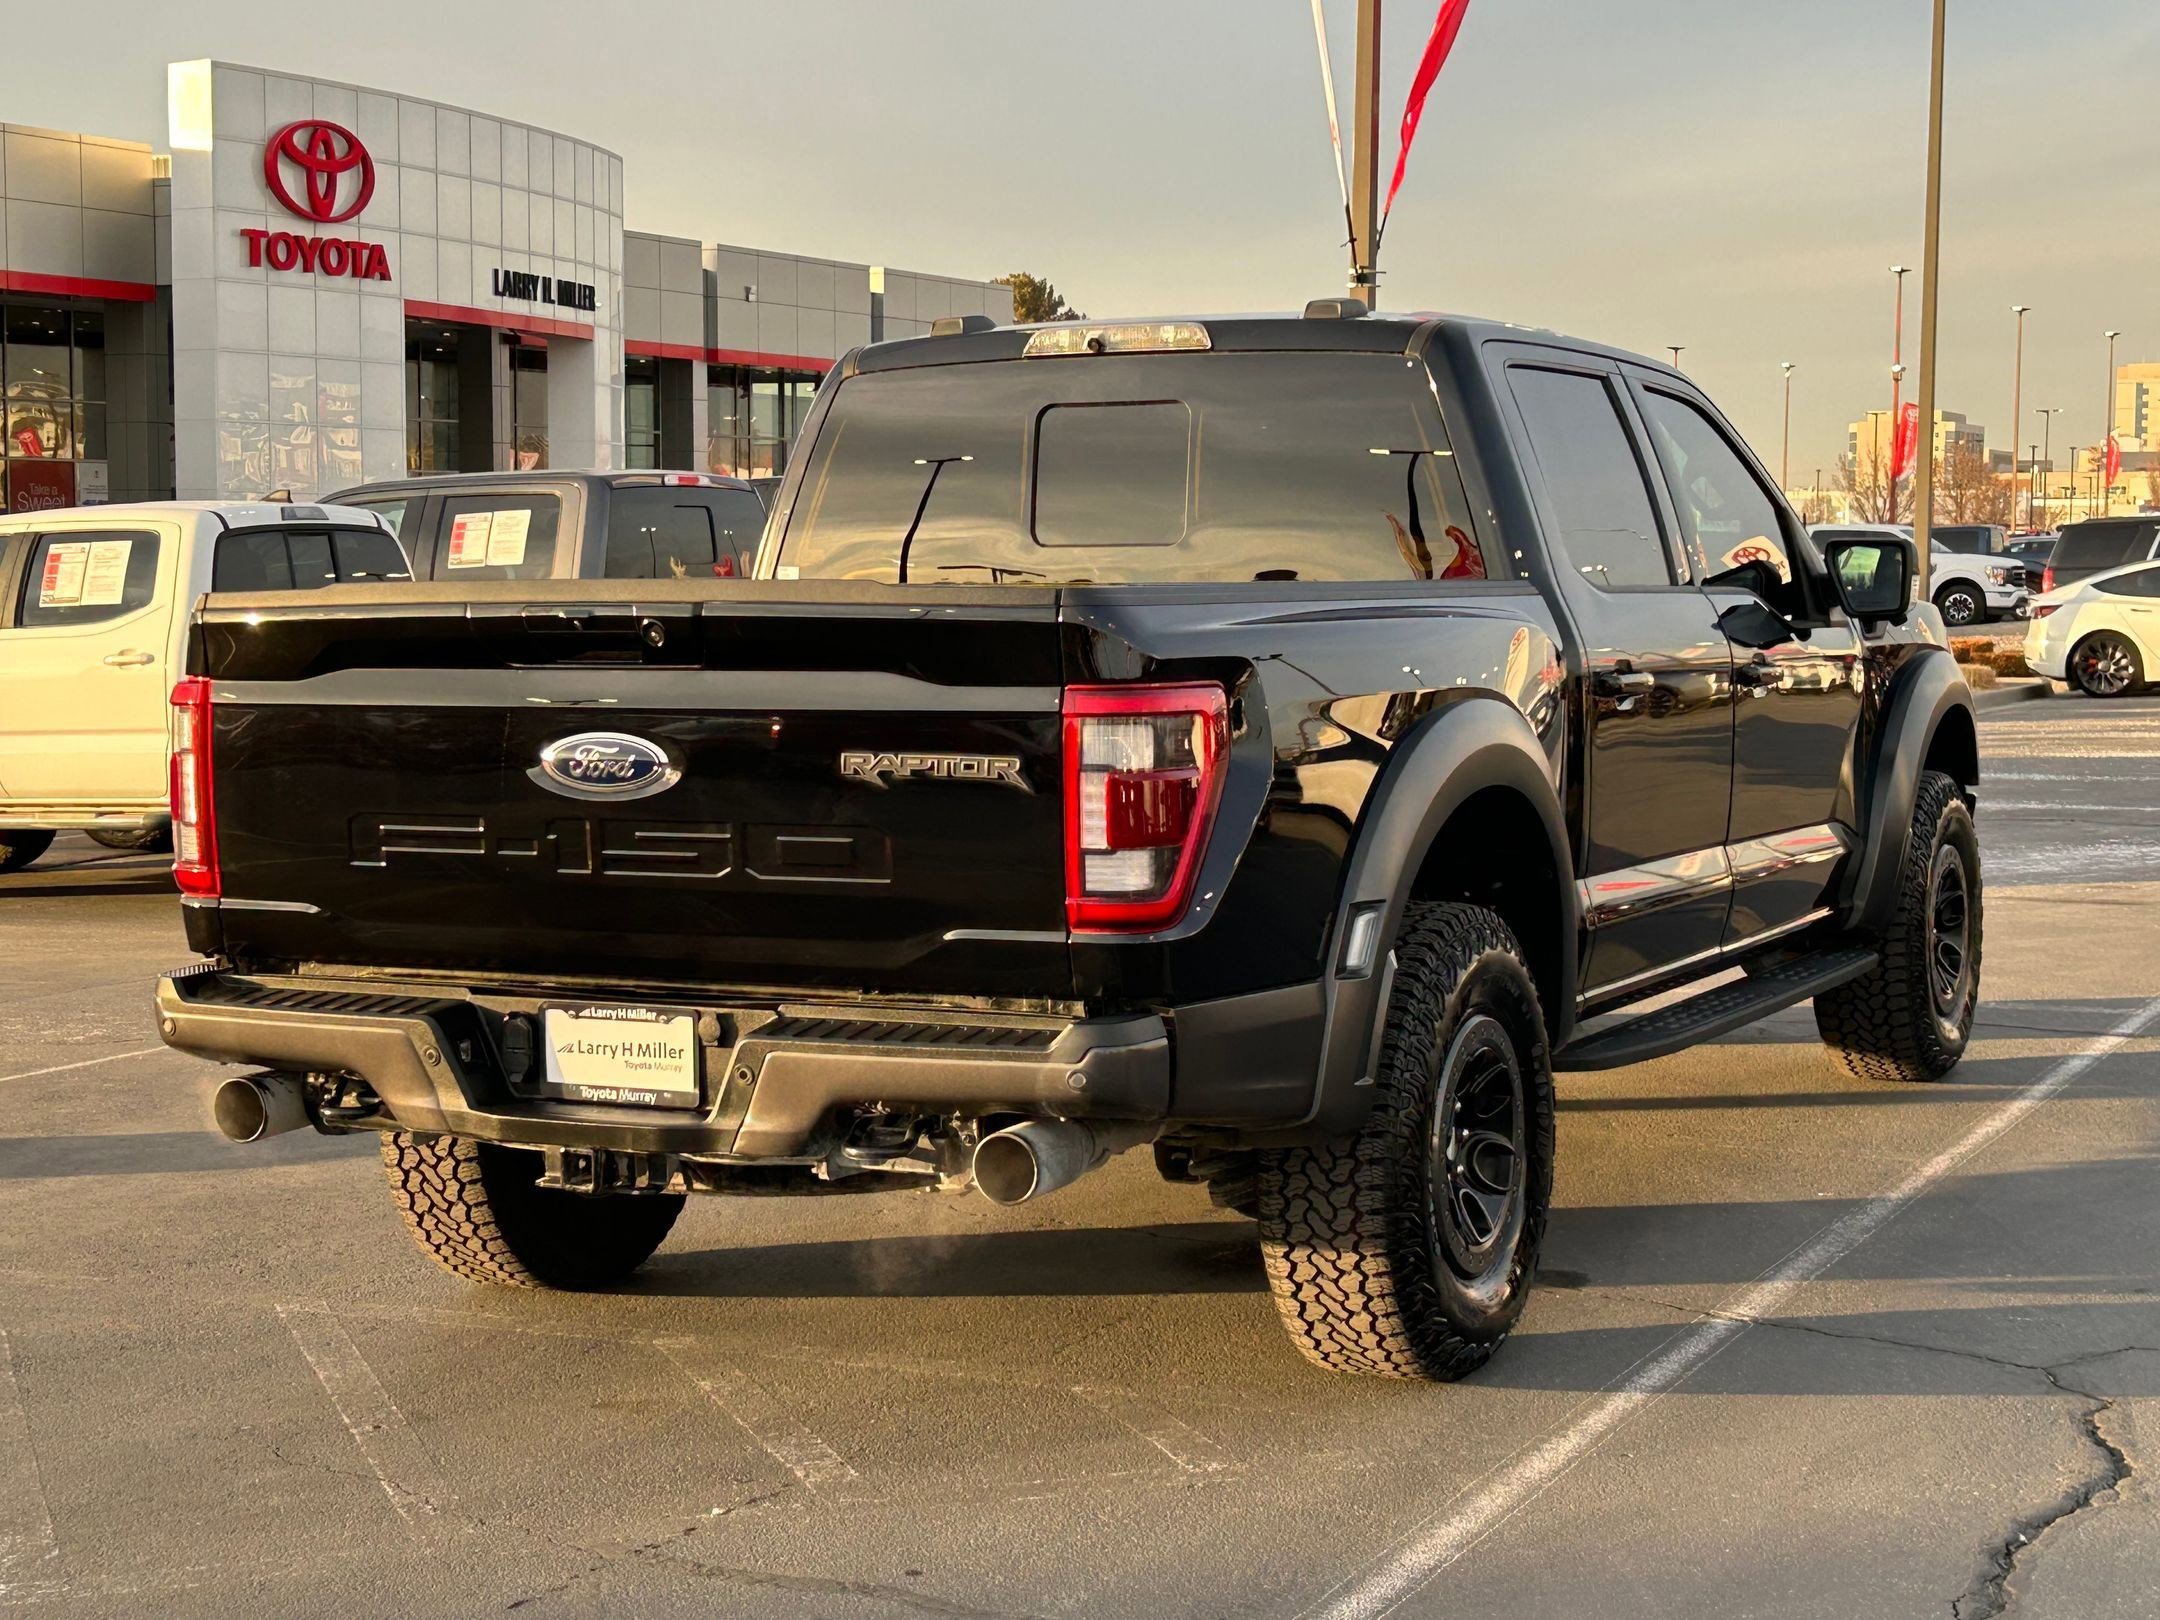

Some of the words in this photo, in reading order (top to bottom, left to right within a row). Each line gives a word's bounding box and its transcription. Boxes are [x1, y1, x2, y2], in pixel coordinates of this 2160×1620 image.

[240, 228, 392, 281] TOYOTA
[493, 268, 540, 301] LARRY
[557, 279, 596, 311] MILLER
[29, 483, 49, 495] Take
[51, 486, 58, 495] a
[17, 491, 66, 511] Sweet
[569, 744, 635, 778] Ford
[840, 752, 1035, 796] RAPTOR
[347, 812, 893, 884] F-150
[591, 1007, 617, 1020] Larry
[627, 1009, 657, 1021] Miller
[578, 1040, 618, 1060] Larry
[622, 1042, 633, 1057] H
[637, 1043, 684, 1060] Miller
[624, 1060, 652, 1071] Toyota
[654, 1062, 683, 1073] Murray
[580, 1086, 617, 1101] Toyota
[618, 1088, 657, 1105] Murray
